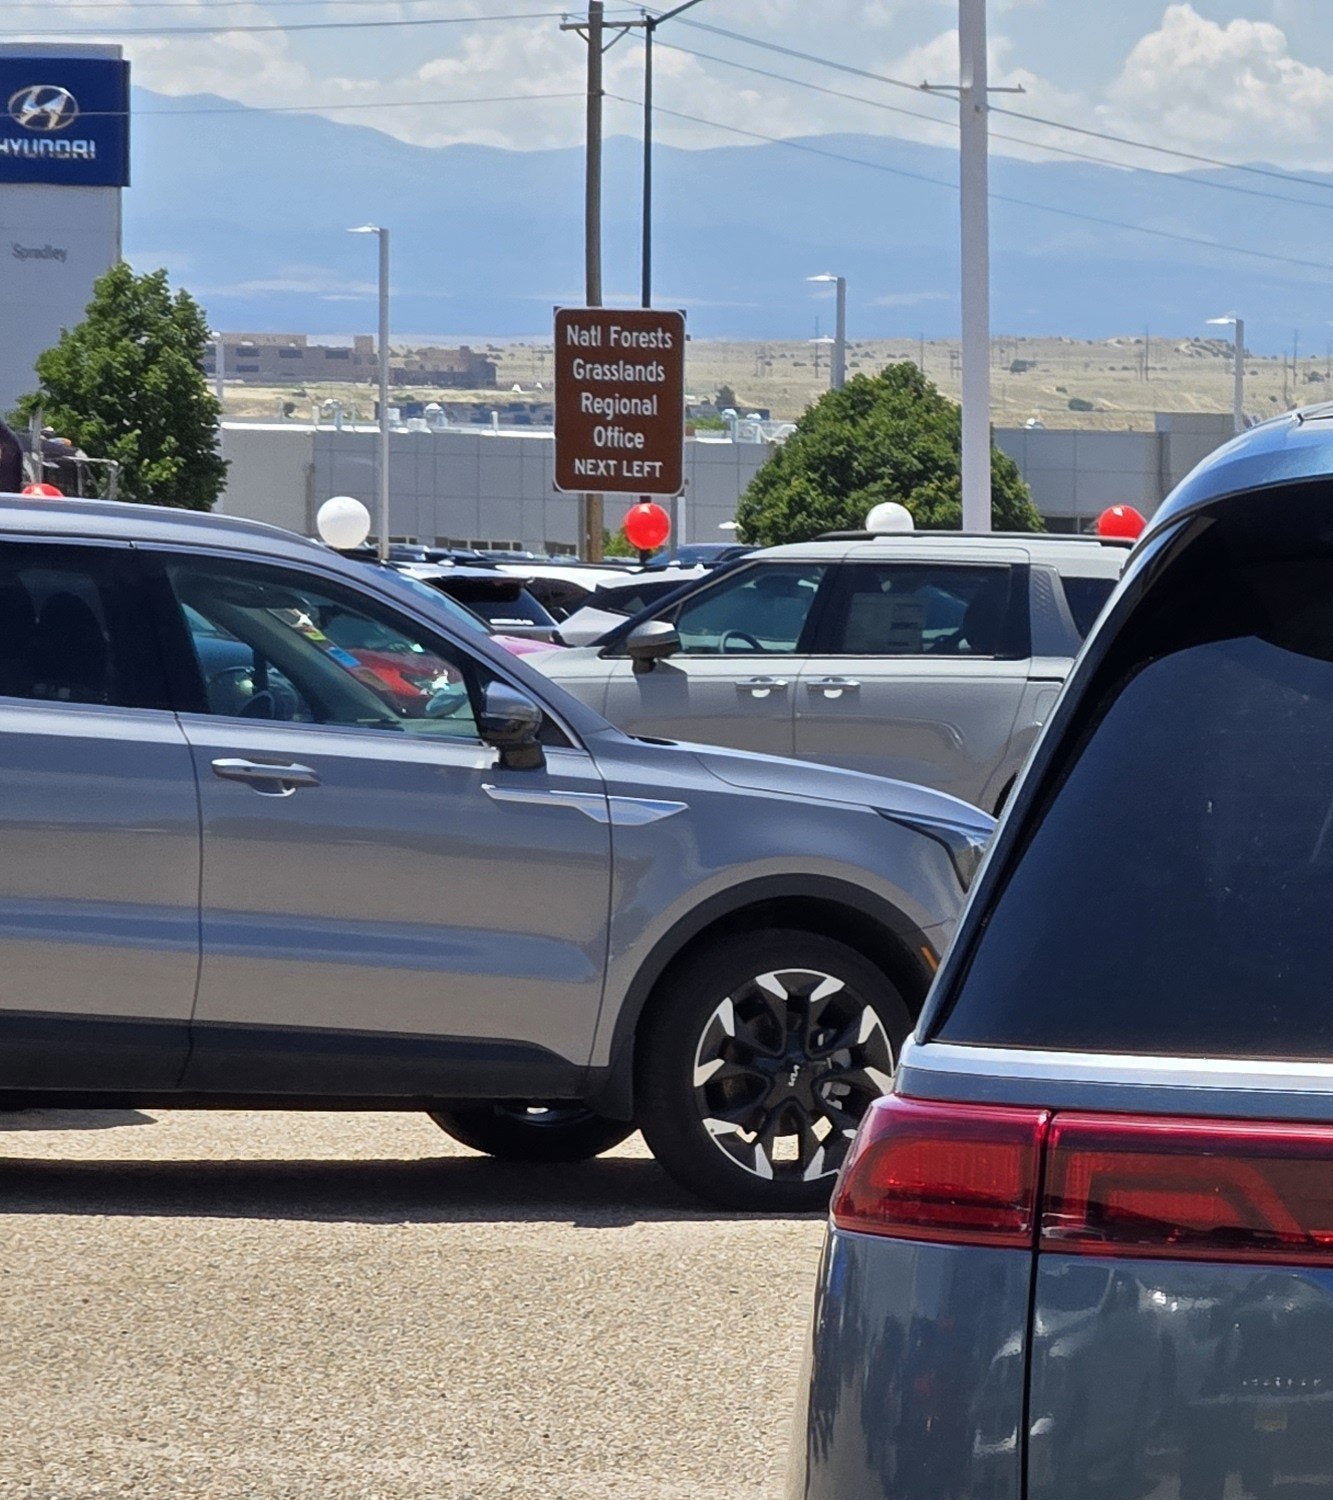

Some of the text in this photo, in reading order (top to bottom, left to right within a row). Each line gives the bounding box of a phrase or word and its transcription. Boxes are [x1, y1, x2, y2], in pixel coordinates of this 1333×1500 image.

[566, 325, 674, 349] Natl Forests
[572, 358, 666, 383] Grasslands
[581, 392, 658, 420] Regional
[593, 425, 645, 449] Office
[574, 458, 664, 478] NEXT LEFT
